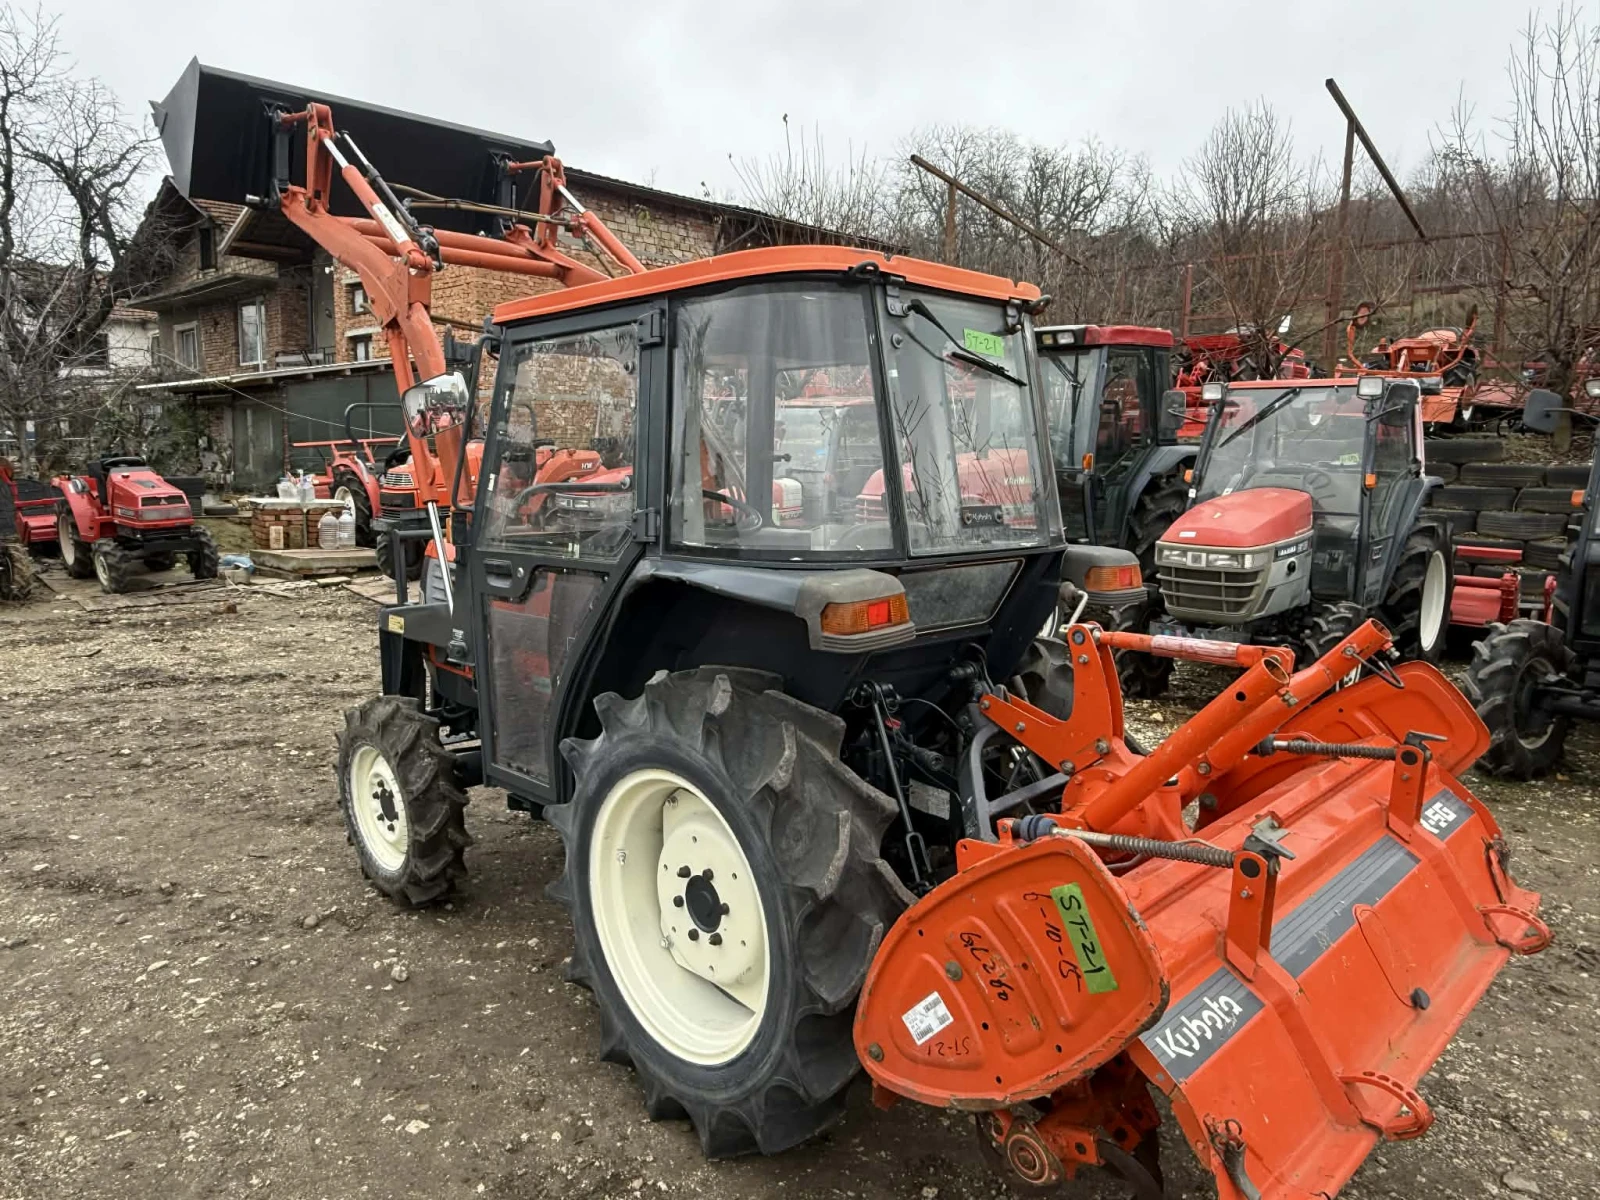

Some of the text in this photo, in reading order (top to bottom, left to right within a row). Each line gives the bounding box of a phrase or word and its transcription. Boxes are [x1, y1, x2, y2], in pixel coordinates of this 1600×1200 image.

[1059, 894, 1106, 974] ST-21
[927, 1036, 970, 1057] ST-21
[1155, 995, 1243, 1059] Kubota
